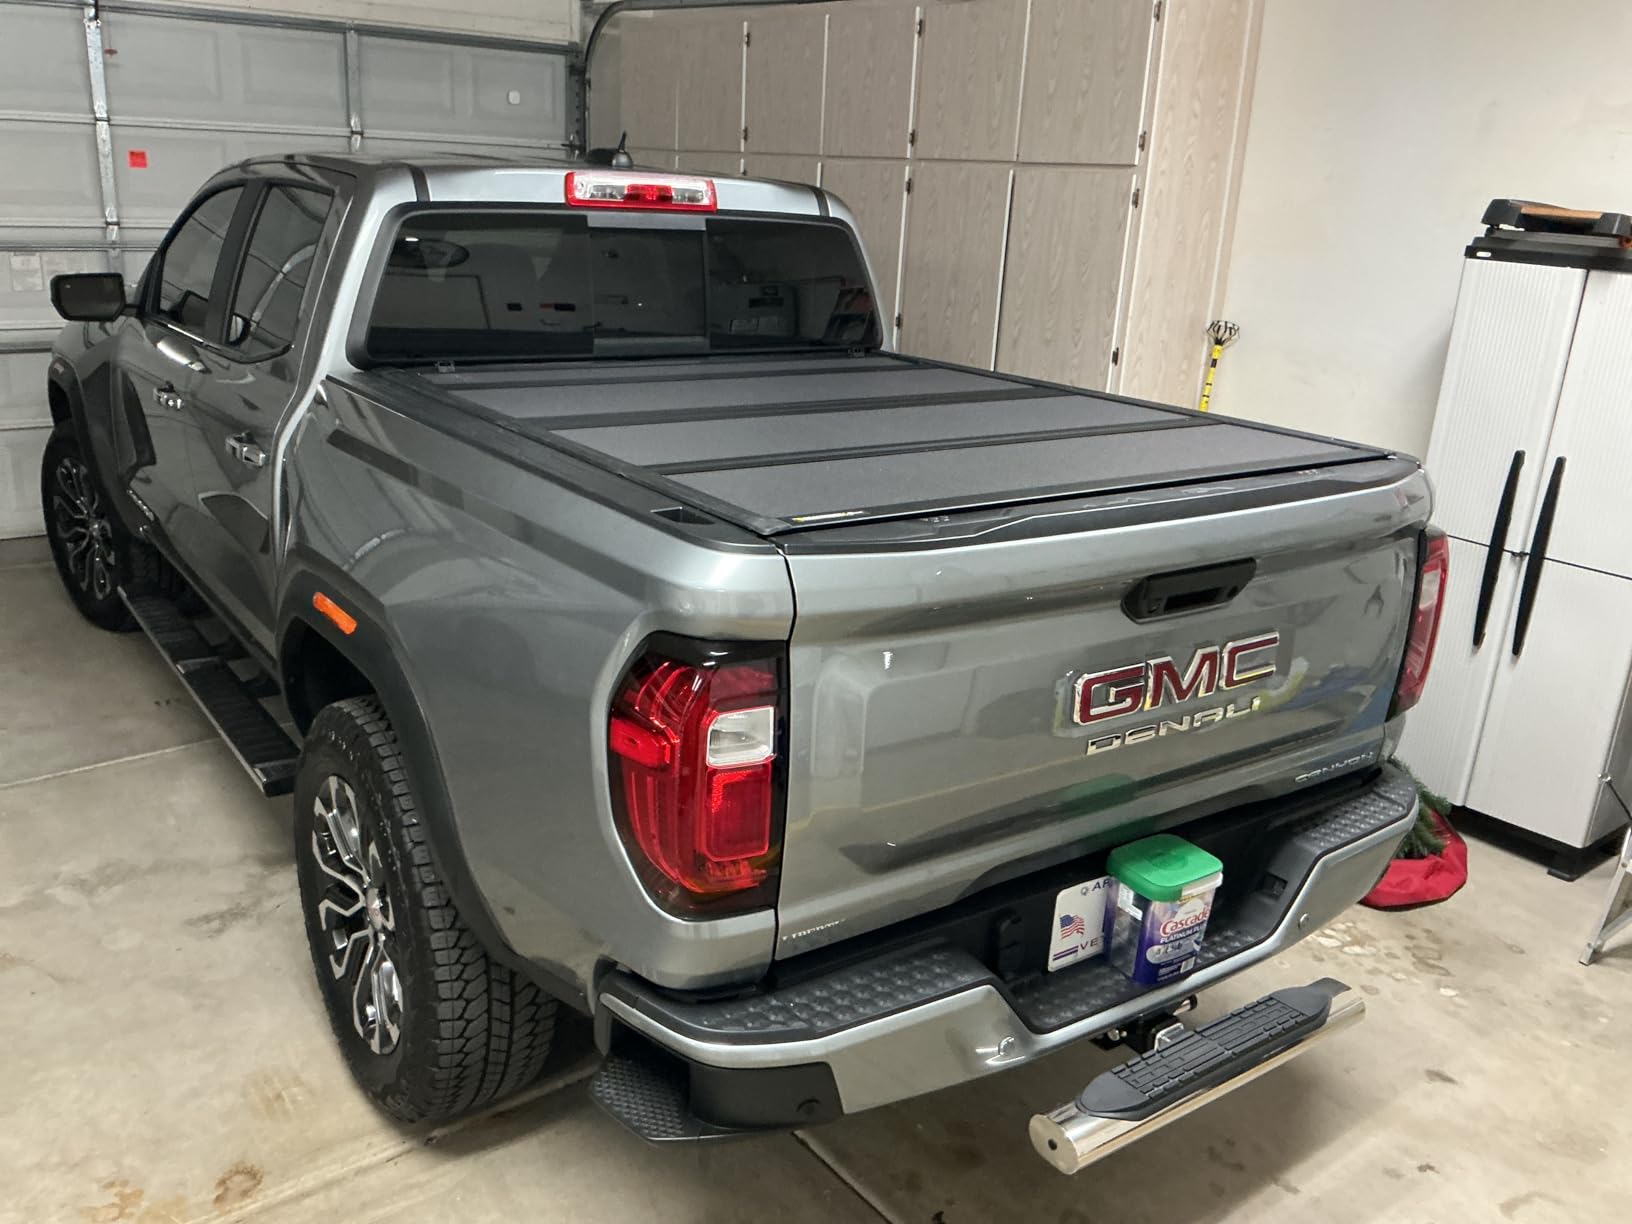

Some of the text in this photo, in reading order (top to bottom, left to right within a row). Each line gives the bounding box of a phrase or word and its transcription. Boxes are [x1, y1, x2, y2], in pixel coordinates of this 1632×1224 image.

[1073, 631, 1280, 726] GMC
[1085, 696, 1262, 756] DENALI
[1294, 751, 1374, 783] CANYON
